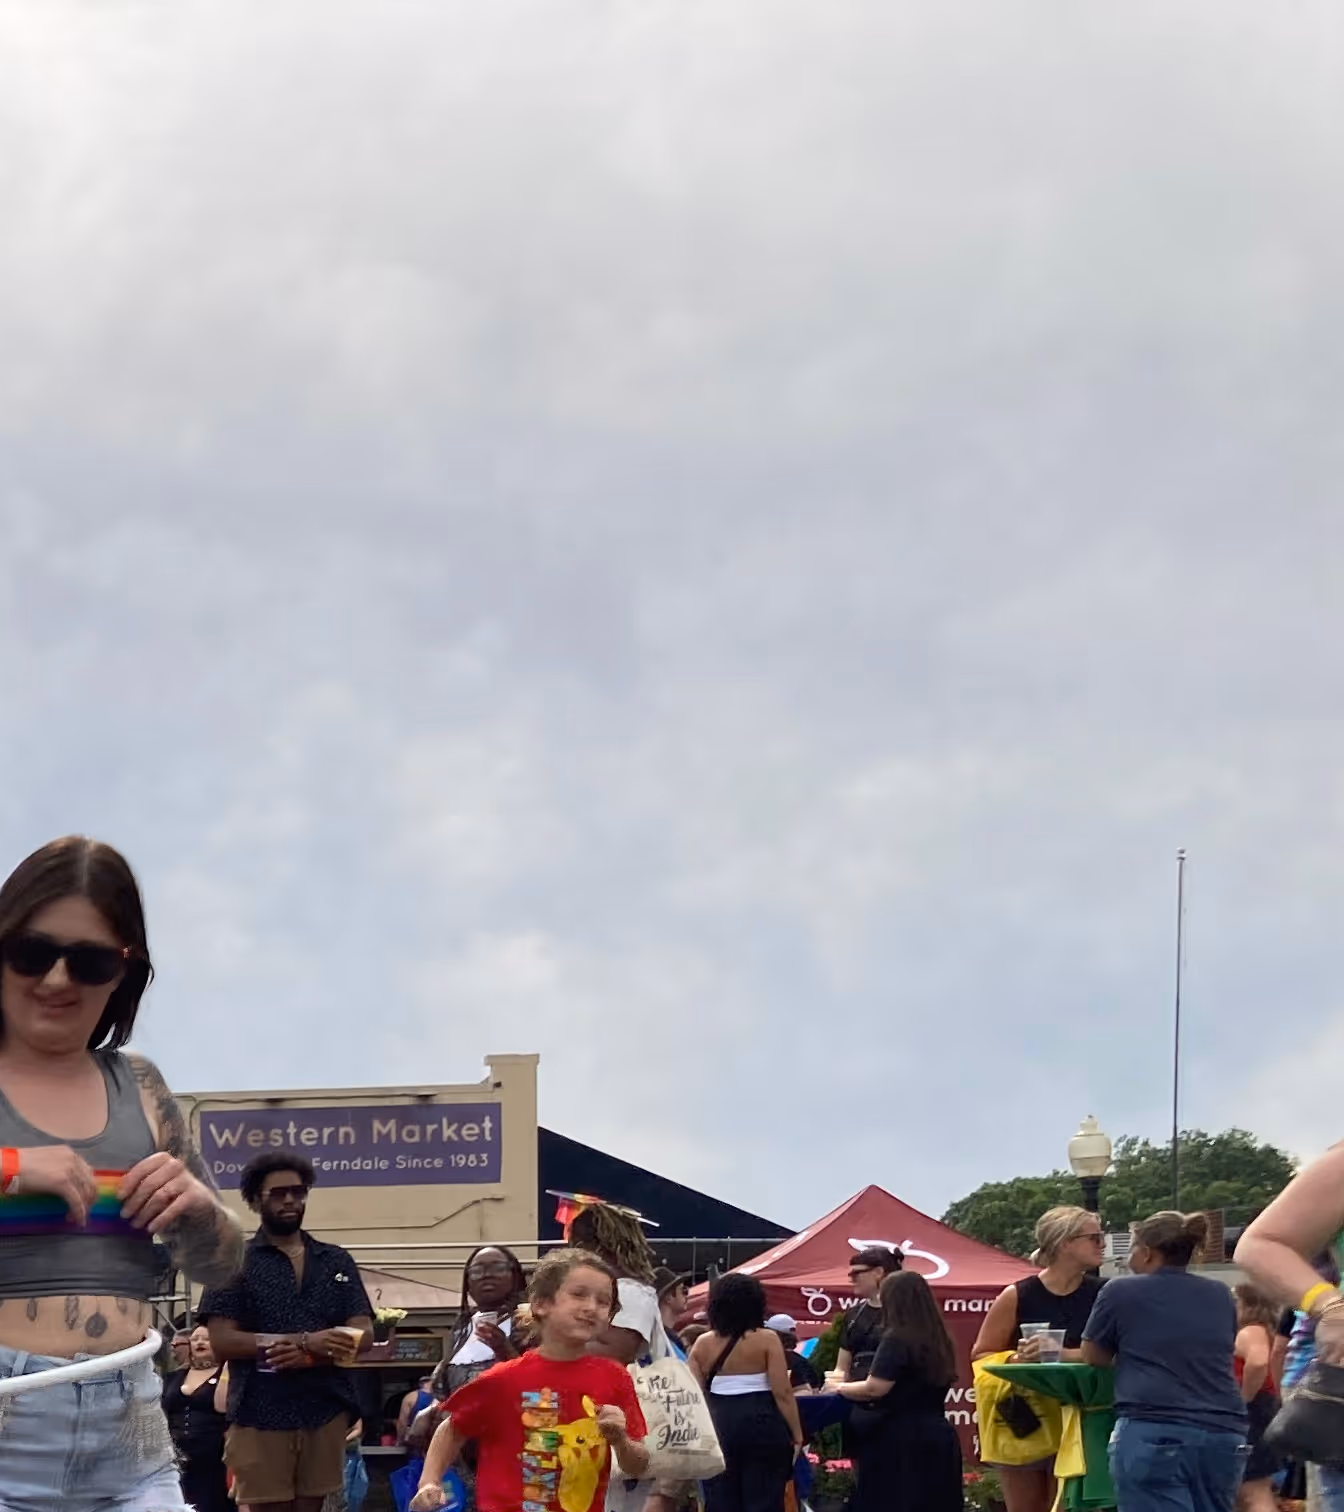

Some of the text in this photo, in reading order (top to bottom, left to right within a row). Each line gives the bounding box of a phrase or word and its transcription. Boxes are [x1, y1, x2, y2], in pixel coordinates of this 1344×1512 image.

[209, 1115, 493, 1149] Western Market
[312, 1153, 488, 1172] Ferndale Since 1983
[662, 1387, 701, 1413] Future
[673, 1408, 686, 1426] is
